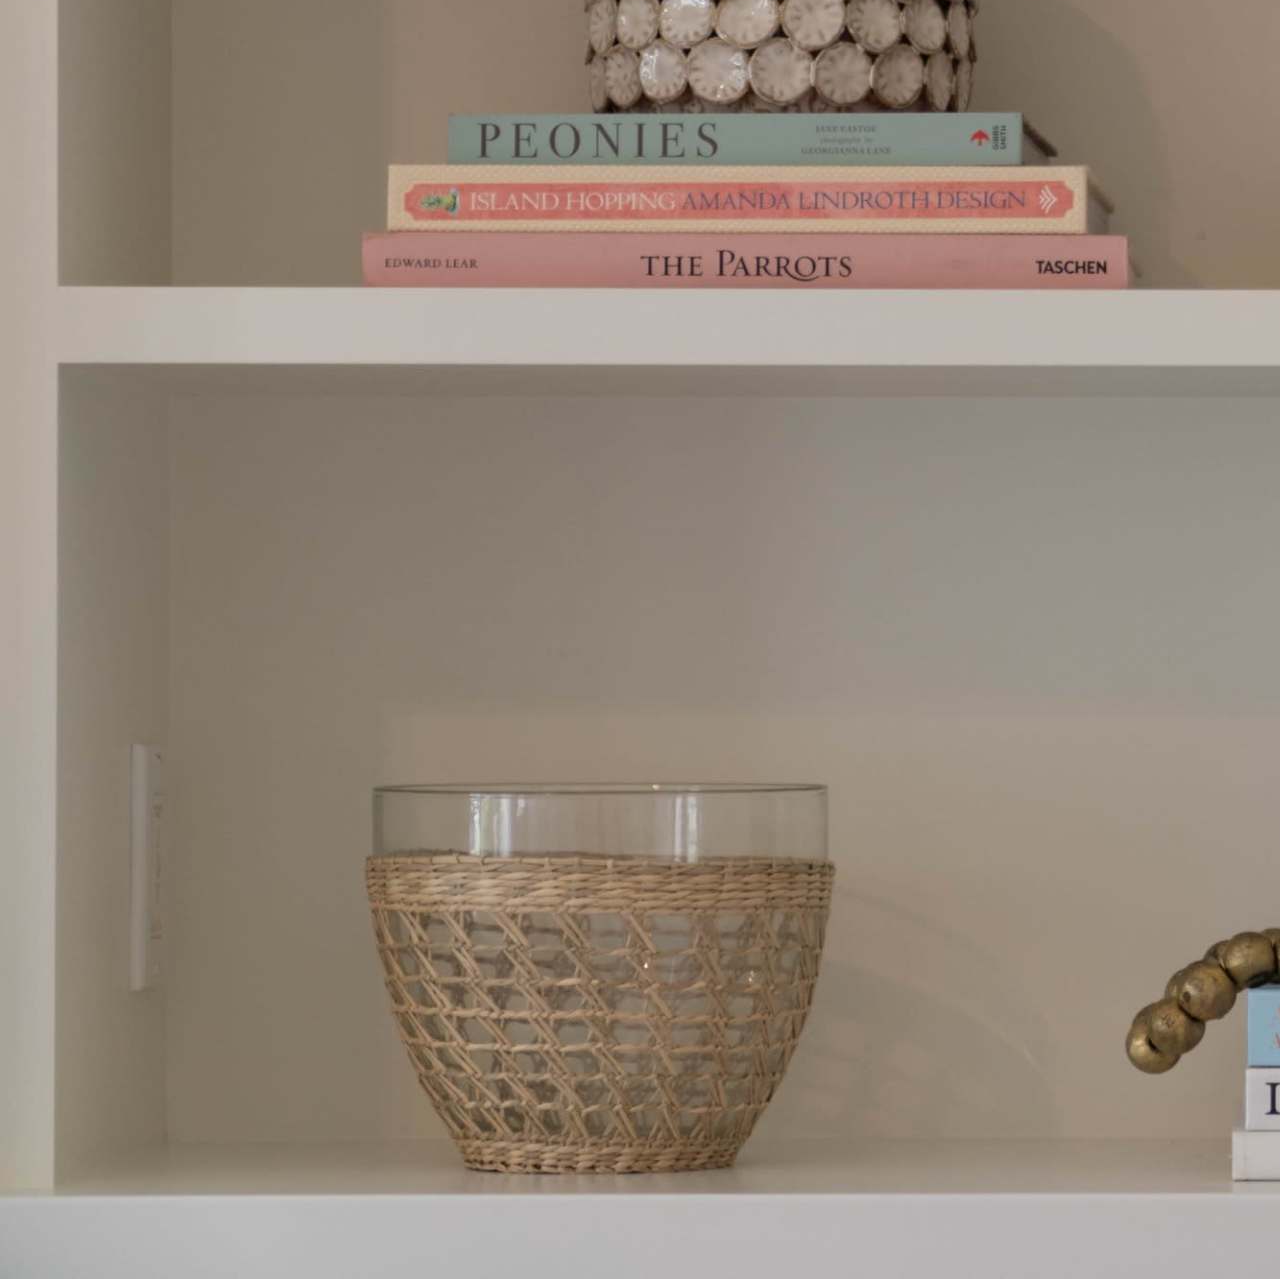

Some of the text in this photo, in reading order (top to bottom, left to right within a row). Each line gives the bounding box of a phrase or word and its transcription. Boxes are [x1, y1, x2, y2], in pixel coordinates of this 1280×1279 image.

[477, 122, 719, 159] PEONIES
[469, 189, 1028, 212] ISLAND HOPPING AMANDA LINDROTH DESIGN
[384, 258, 479, 270] EDWARD LEAR
[640, 249, 852, 282] THE PARROTS
[1035, 260, 1108, 275] TASCHEN
